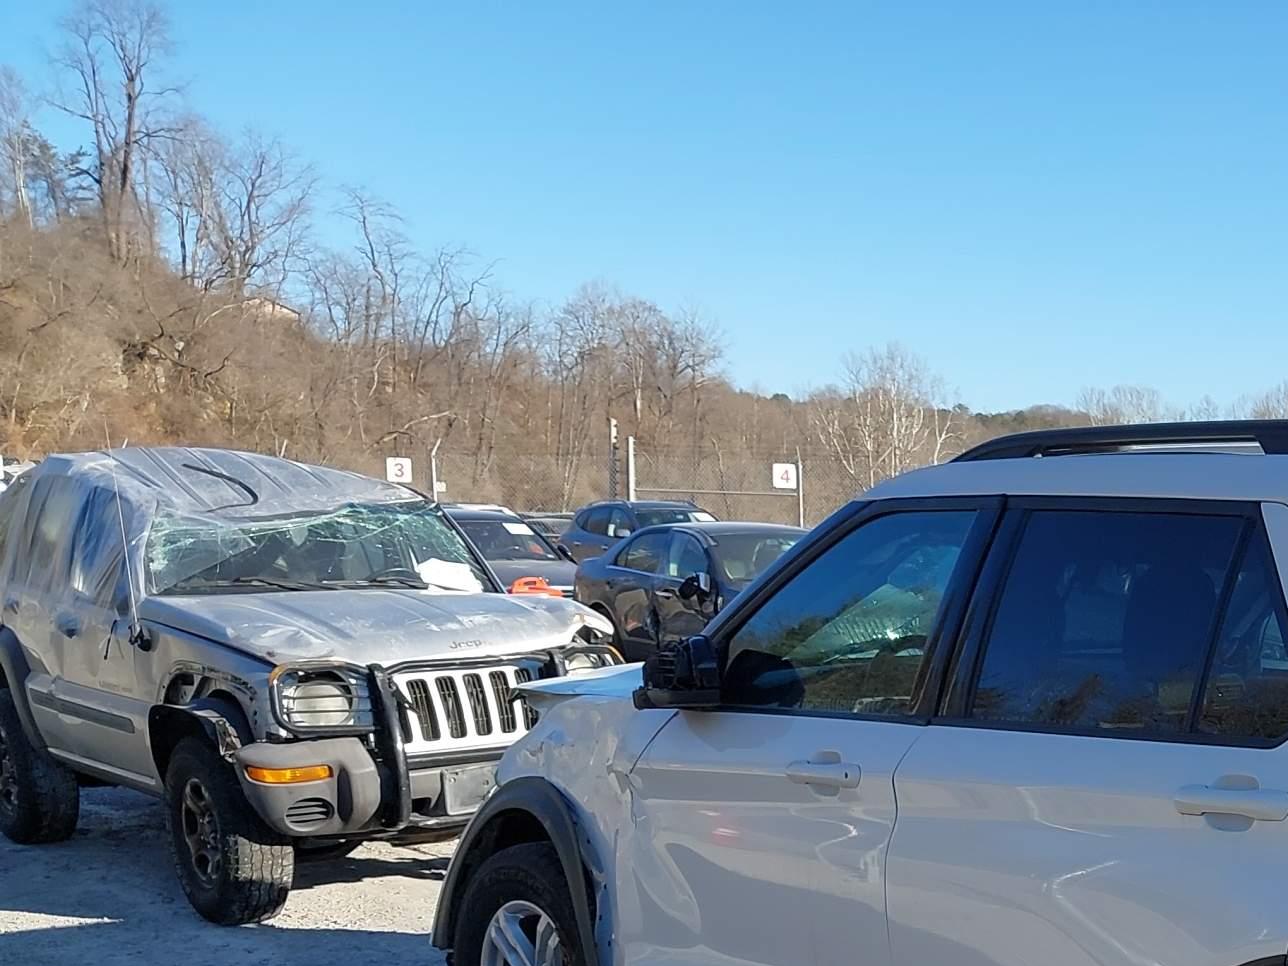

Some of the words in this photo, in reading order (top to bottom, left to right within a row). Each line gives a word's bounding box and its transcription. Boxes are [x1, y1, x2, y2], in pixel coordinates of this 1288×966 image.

[394, 462, 405, 478] 3
[780, 469, 791, 484] 4
[449, 640, 482, 649] Jeep
